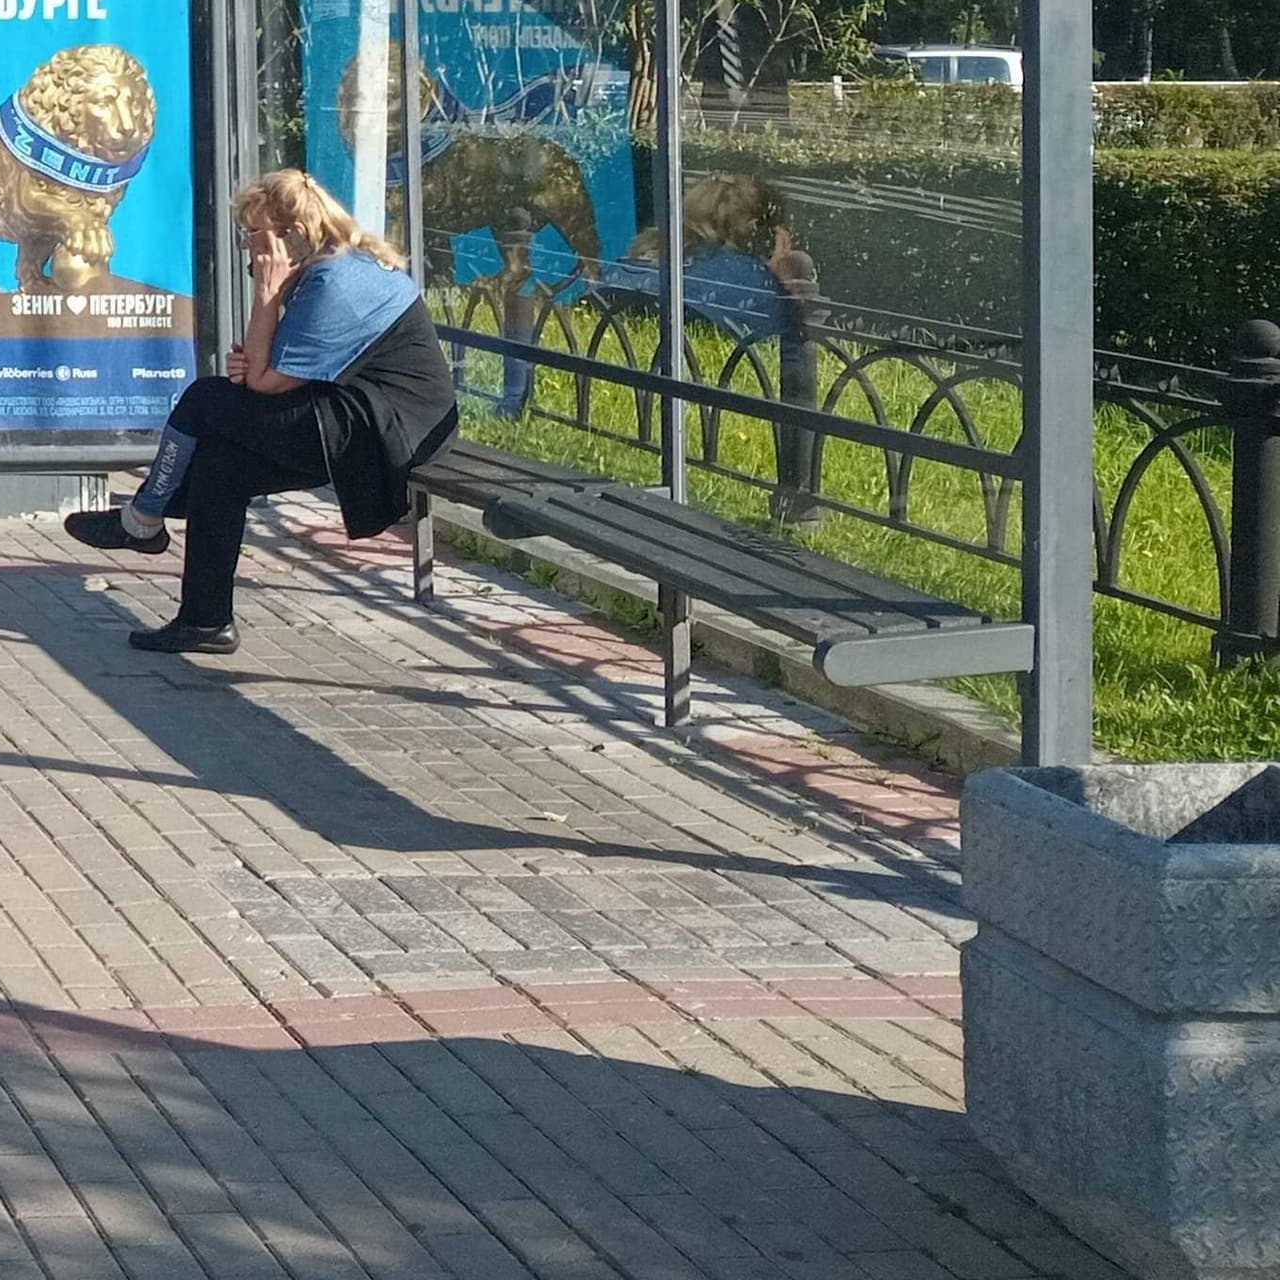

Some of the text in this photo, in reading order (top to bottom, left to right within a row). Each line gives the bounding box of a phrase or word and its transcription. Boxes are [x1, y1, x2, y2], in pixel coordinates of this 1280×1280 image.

[11, 294, 175, 316] ЗЕНИТ ПЕТЕРБУРГ
[139, 316, 173, 328] ВМЕСТЕ
[72, 368, 97, 379] Russ
